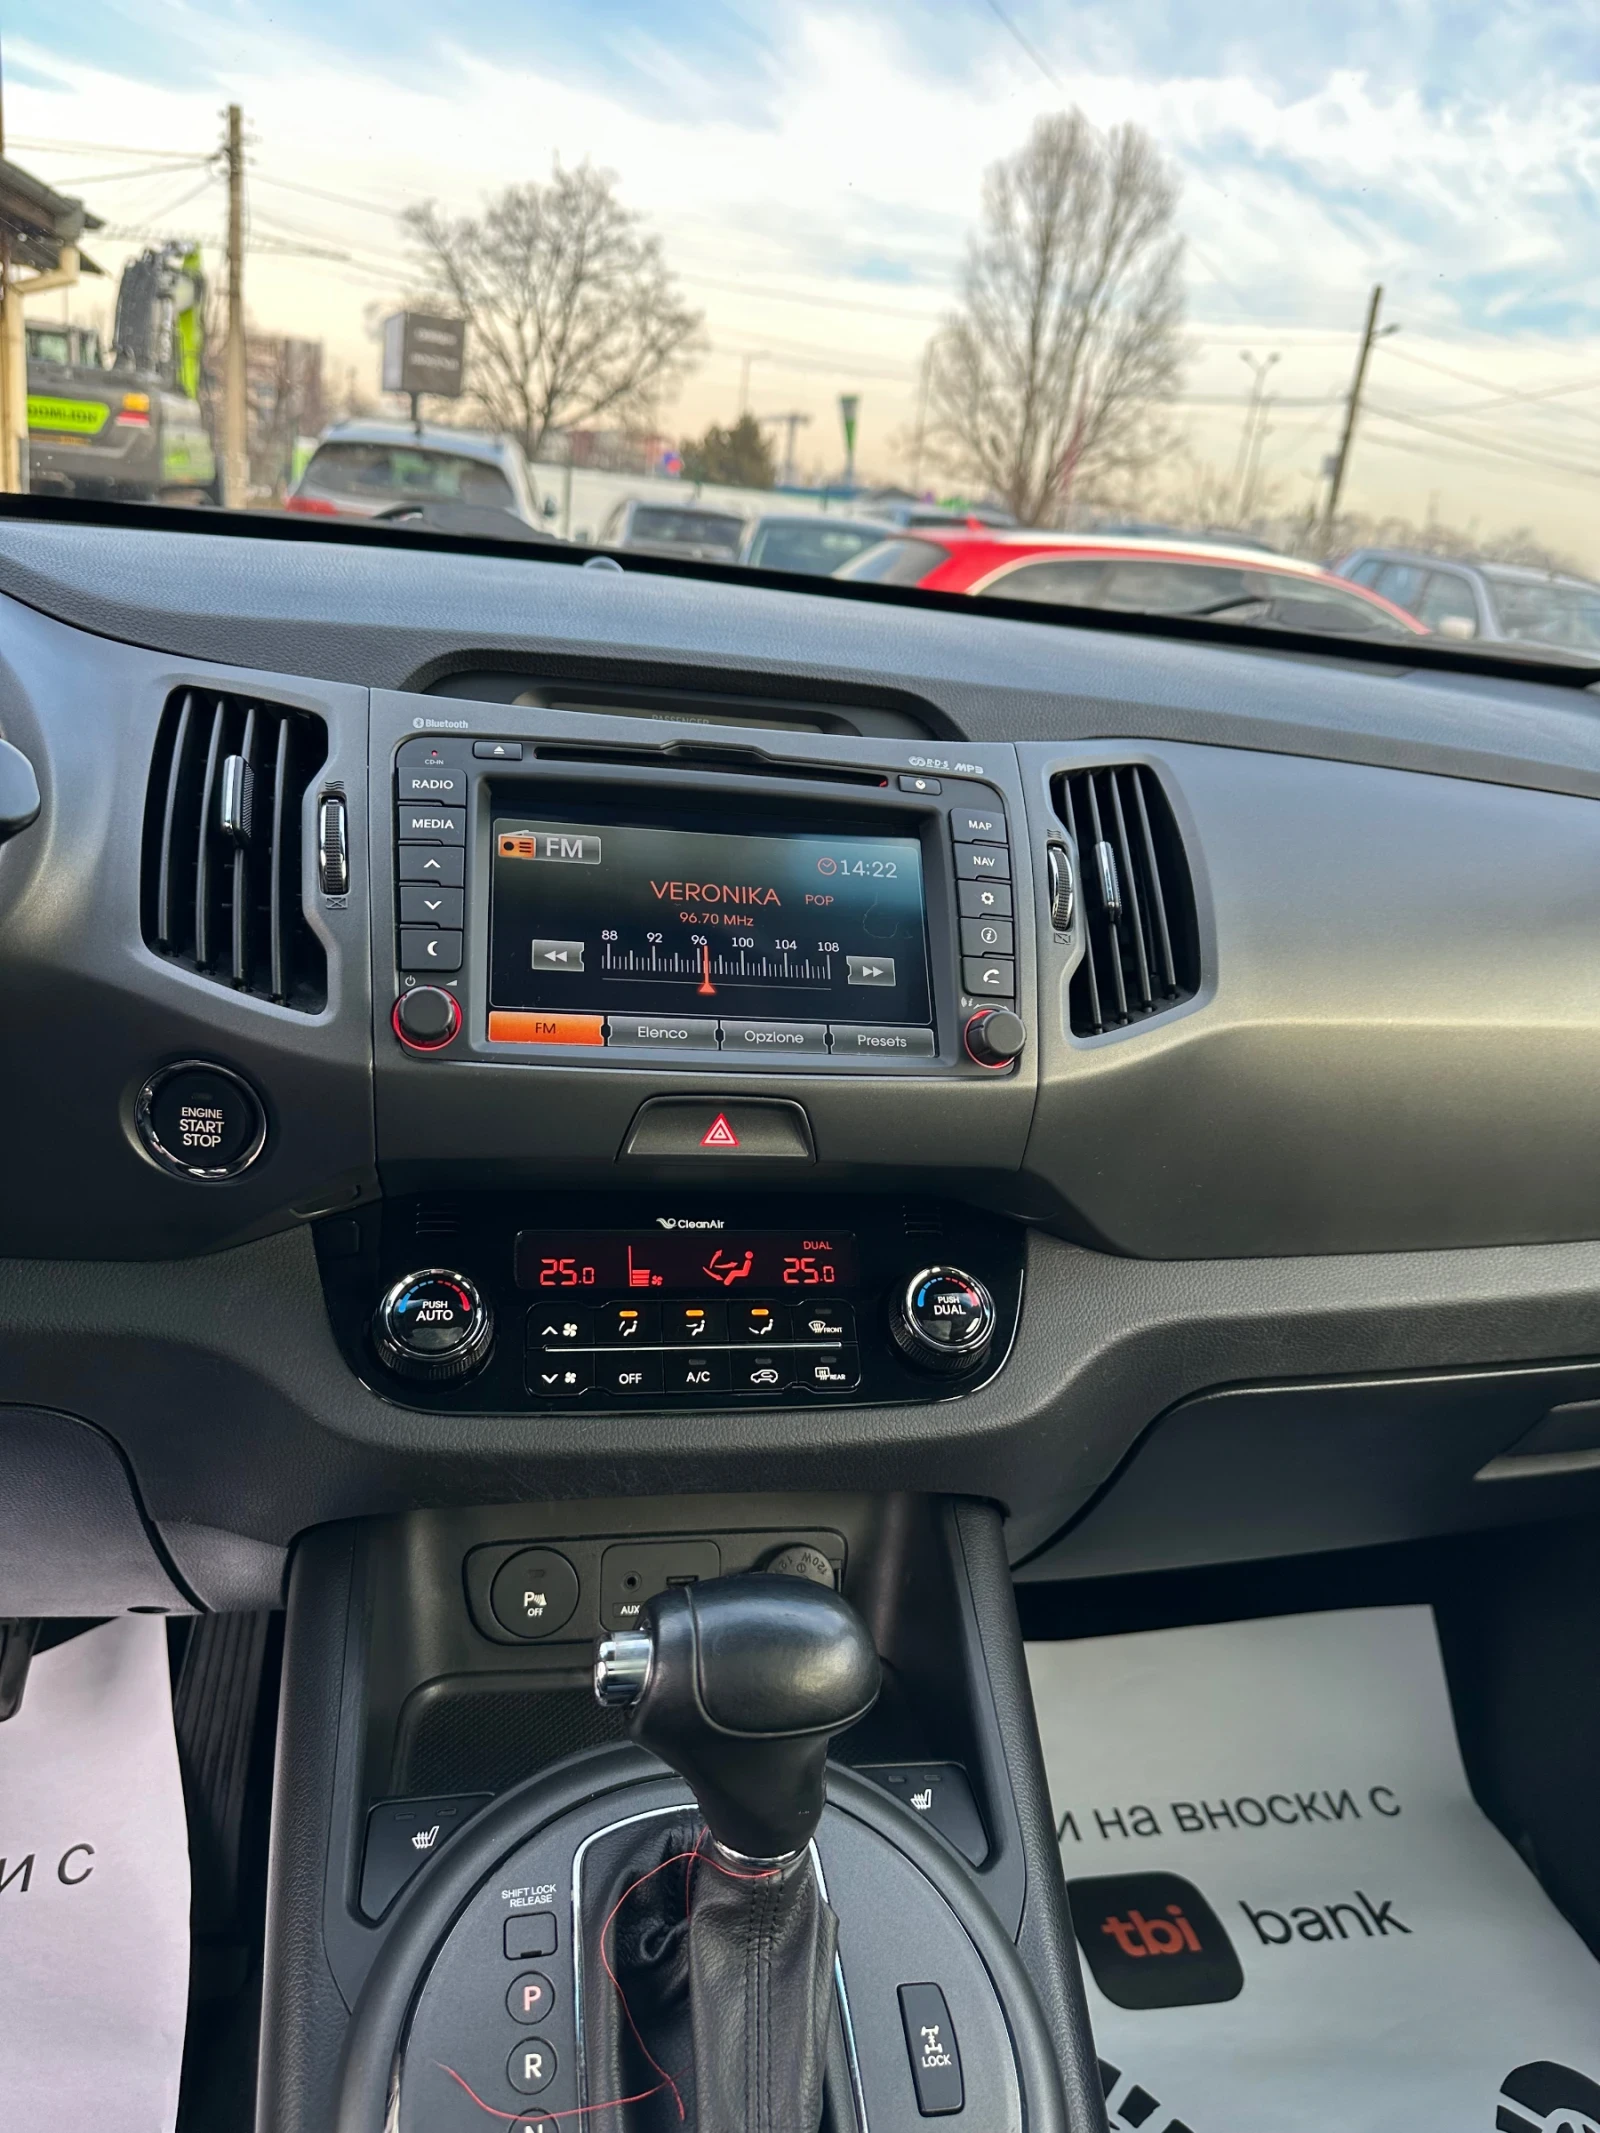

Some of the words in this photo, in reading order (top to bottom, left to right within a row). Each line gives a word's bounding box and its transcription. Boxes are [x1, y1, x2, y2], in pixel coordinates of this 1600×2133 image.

[425, 719, 468, 730] Bluetooth
[424, 758, 444, 766] CD-IN
[954, 762, 984, 774] MP3
[411, 778, 454, 791] RADIO
[411, 817, 454, 831] MEDIA
[968, 819, 993, 831] MAP
[545, 837, 584, 859] FM
[973, 855, 996, 868] NAV
[840, 859, 898, 879] 14:22
[650, 880, 782, 907] VERONIKA
[805, 894, 834, 906] POP
[679, 911, 719, 924] 96.70
[723, 913, 754, 927] MHz
[601, 930, 618, 941] 88
[646, 932, 663, 943] 92
[691, 935, 708, 946] 96
[731, 937, 755, 949] 100
[774, 939, 798, 950] 104
[817, 941, 840, 953] 108
[535, 1022, 556, 1035] FM
[637, 1026, 688, 1041] Elenco
[744, 1029, 804, 1045] Opzione
[857, 1034, 907, 1048] Presets
[181, 1107, 223, 1119] ENGINE
[179, 1118, 225, 1134] START
[182, 1133, 222, 1148] STOP
[677, 1219, 725, 1229] CleanAir
[803, 1241, 832, 1250] DUAL
[539, 1258, 594, 1286] 25.0
[783, 1257, 835, 1284] 25.0
[422, 1300, 448, 1310] PUSH
[937, 1295, 960, 1304] PUSH
[416, 1309, 453, 1322] AUTO
[933, 1304, 967, 1316] DUAL
[618, 1372, 642, 1385] OFF
[685, 1371, 711, 1383] A/C
[829, 1373, 846, 1381] REAR
[527, 1607, 543, 1617] OFF
[620, 1604, 641, 1616] AUX
[1093, 1803, 1163, 1840] на
[1170, 1788, 1361, 1835] вноски
[1370, 1786, 1402, 1817] с
[501, 1886, 530, 1900] SHIFT
[531, 1883, 557, 1896] LOCK
[509, 1893, 553, 1908] RELEASE
[1102, 1905, 1202, 1957] tbi
[1239, 1890, 1413, 1946] bank
[523, 1985, 542, 2011] P
[524, 2053, 543, 2079] R
[921, 2053, 952, 2068] LOCK
